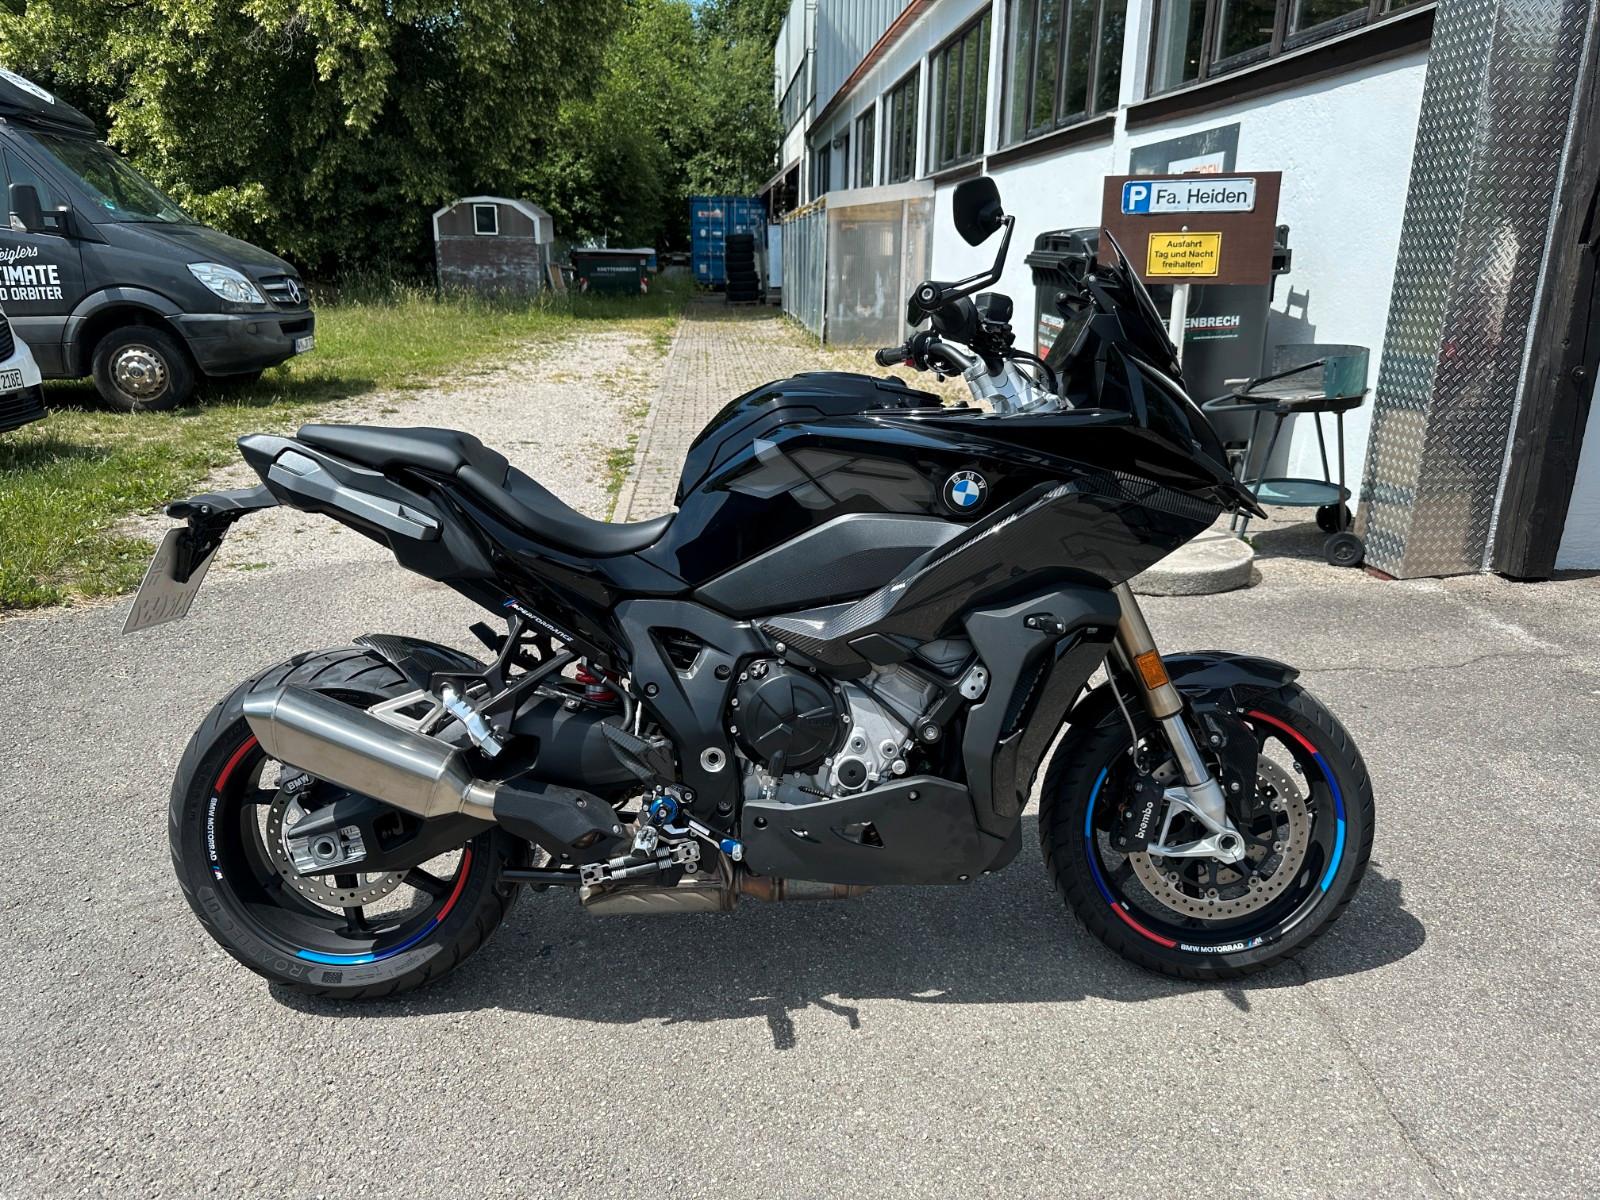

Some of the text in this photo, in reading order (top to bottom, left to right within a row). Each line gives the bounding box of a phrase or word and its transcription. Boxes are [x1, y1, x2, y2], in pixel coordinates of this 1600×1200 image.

[1128, 185, 1248, 210] P Fa. Heiden
[1166, 240, 1203, 248] Ausfahrt
[0, 245, 38, 264] eiglers
[1154, 249, 1214, 259] Tag und Nacht
[1162, 259, 1204, 269] freihalten!
[0, 264, 60, 285] IMATE
[10, 286, 63, 300] ORBITER
[287, 773, 309, 790] BMW
[208, 797, 218, 816] BMW
[1135, 801, 1154, 839] brembo
[207, 817, 218, 861] MOTORRAD
[1180, 943, 1200, 952] BMW
[1200, 943, 1244, 953] MOTORRAD
